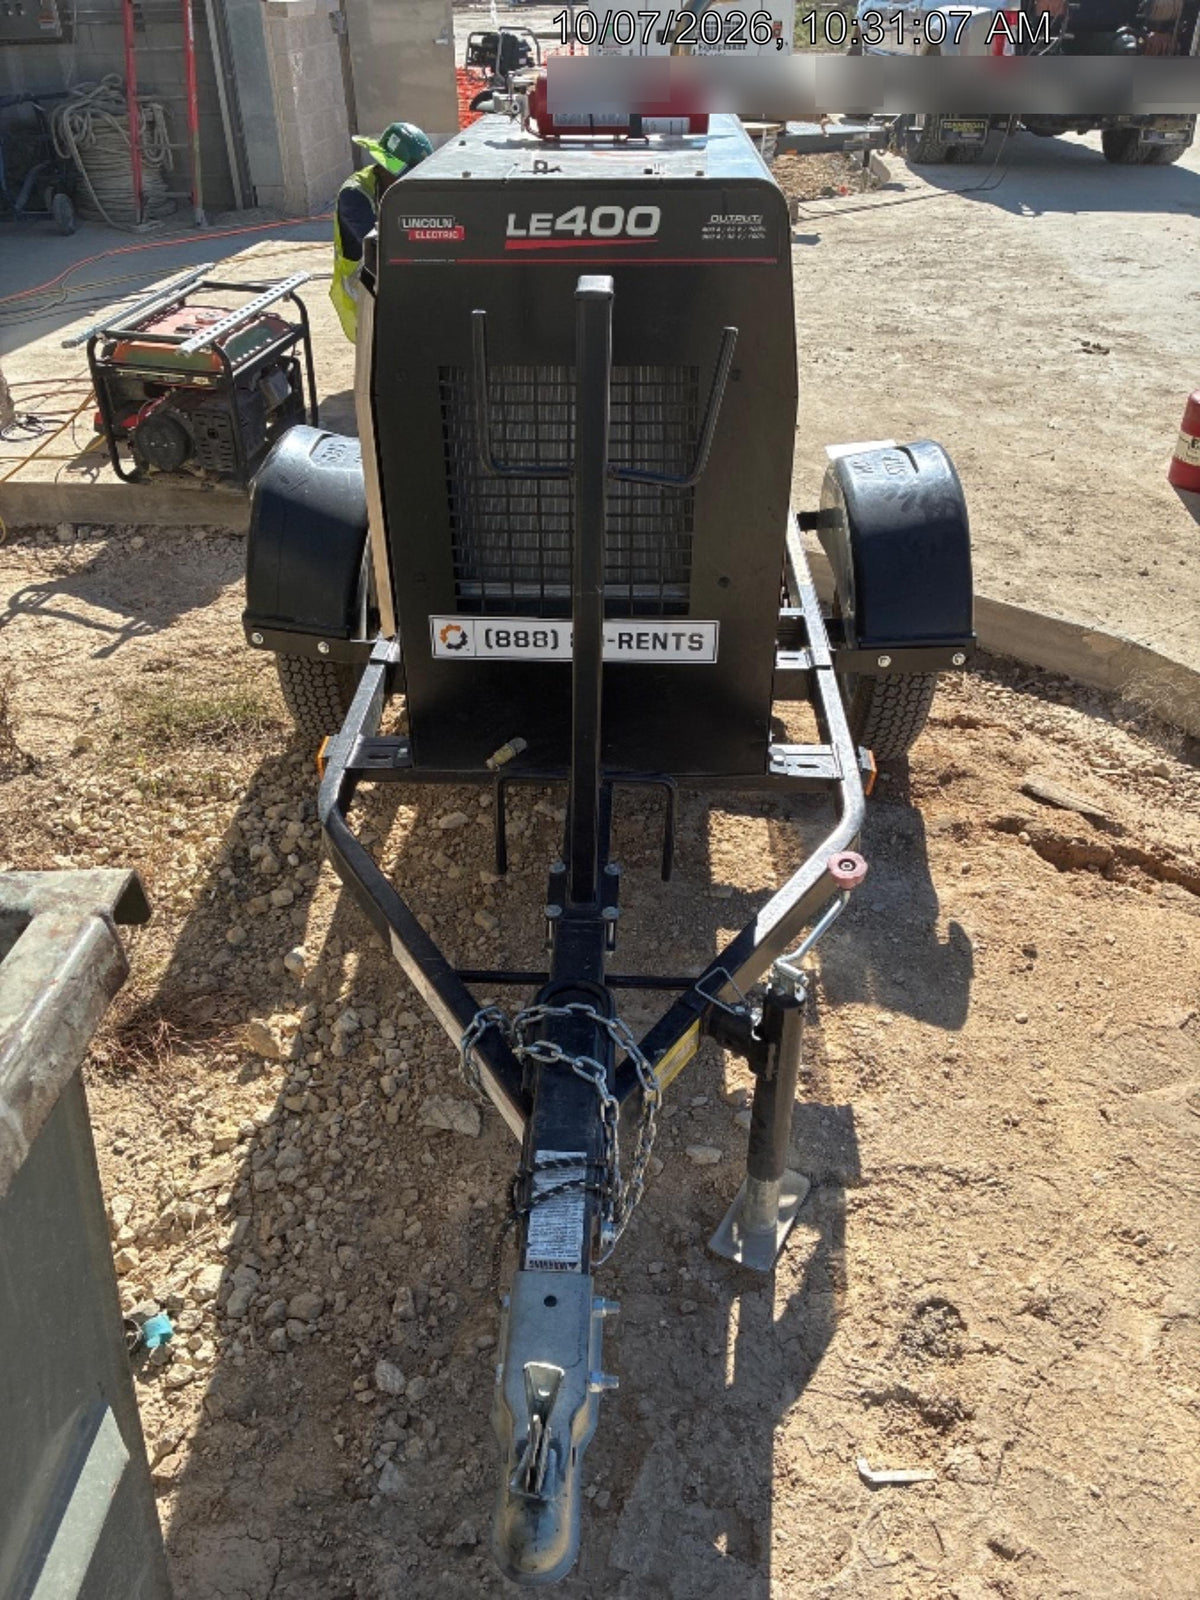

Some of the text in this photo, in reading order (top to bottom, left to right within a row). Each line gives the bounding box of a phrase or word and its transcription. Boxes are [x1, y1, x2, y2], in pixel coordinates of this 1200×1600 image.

[402, 217, 453, 229] LINCOLN
[506, 205, 661, 237] LE400
[710, 214, 760, 223] OUTPUT
[415, 230, 459, 239] ELECTRIC
[484, 628, 559, 651] (888)
